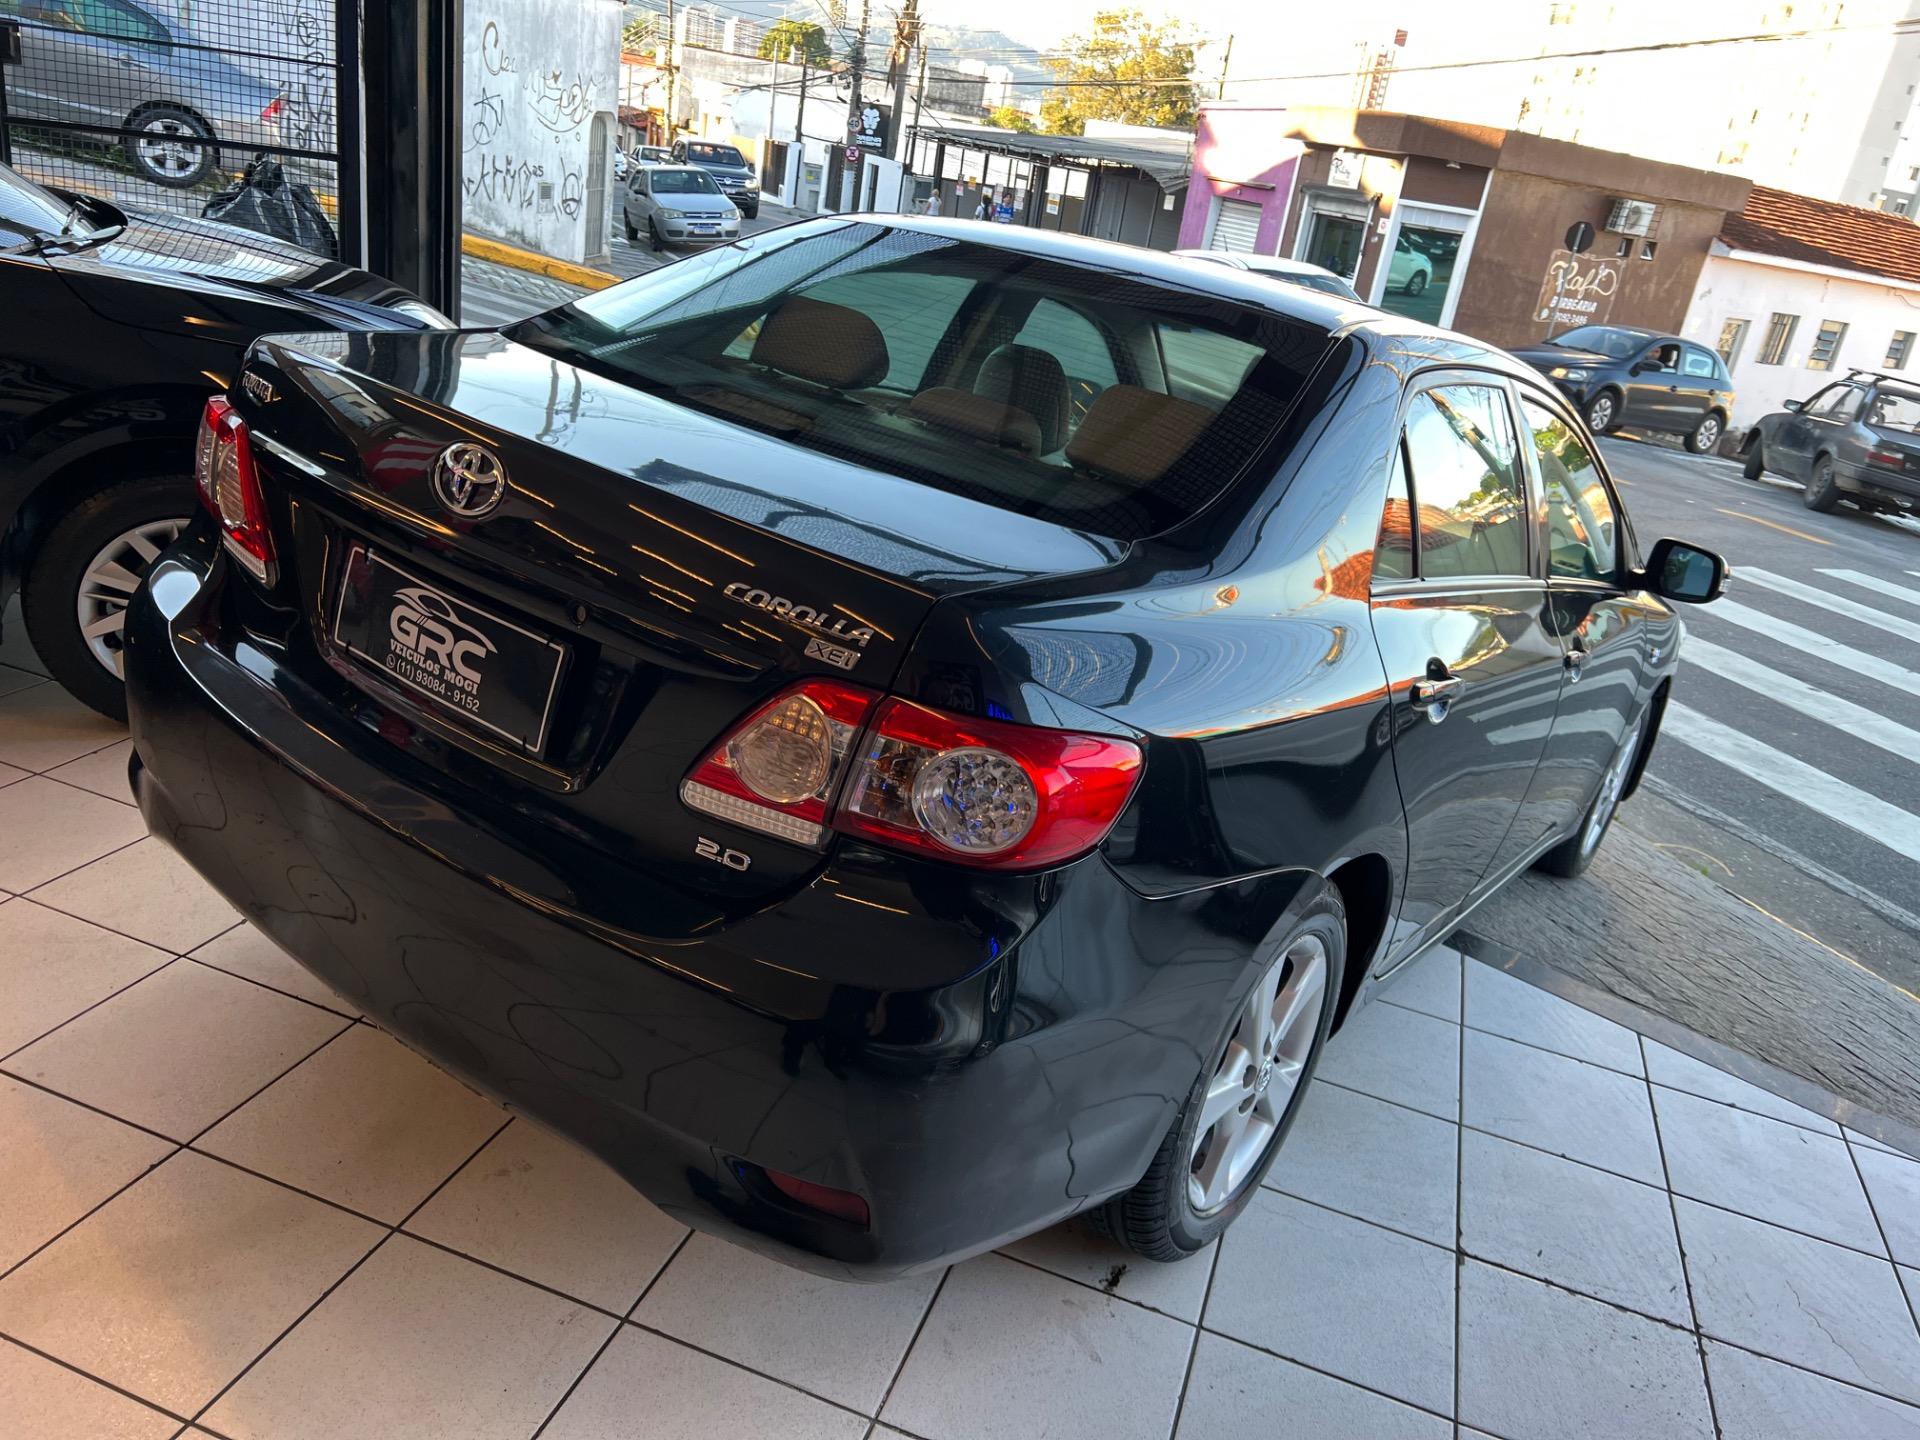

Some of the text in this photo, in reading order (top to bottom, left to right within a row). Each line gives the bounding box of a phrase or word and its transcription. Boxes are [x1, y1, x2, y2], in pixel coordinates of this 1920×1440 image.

[723, 582, 875, 648] COROLLA
[390, 604, 487, 684] GRC
[390, 638, 479, 695] VEICULOS MOGI
[396, 659, 415, 681] (11)
[695, 836, 751, 871] 2.0
